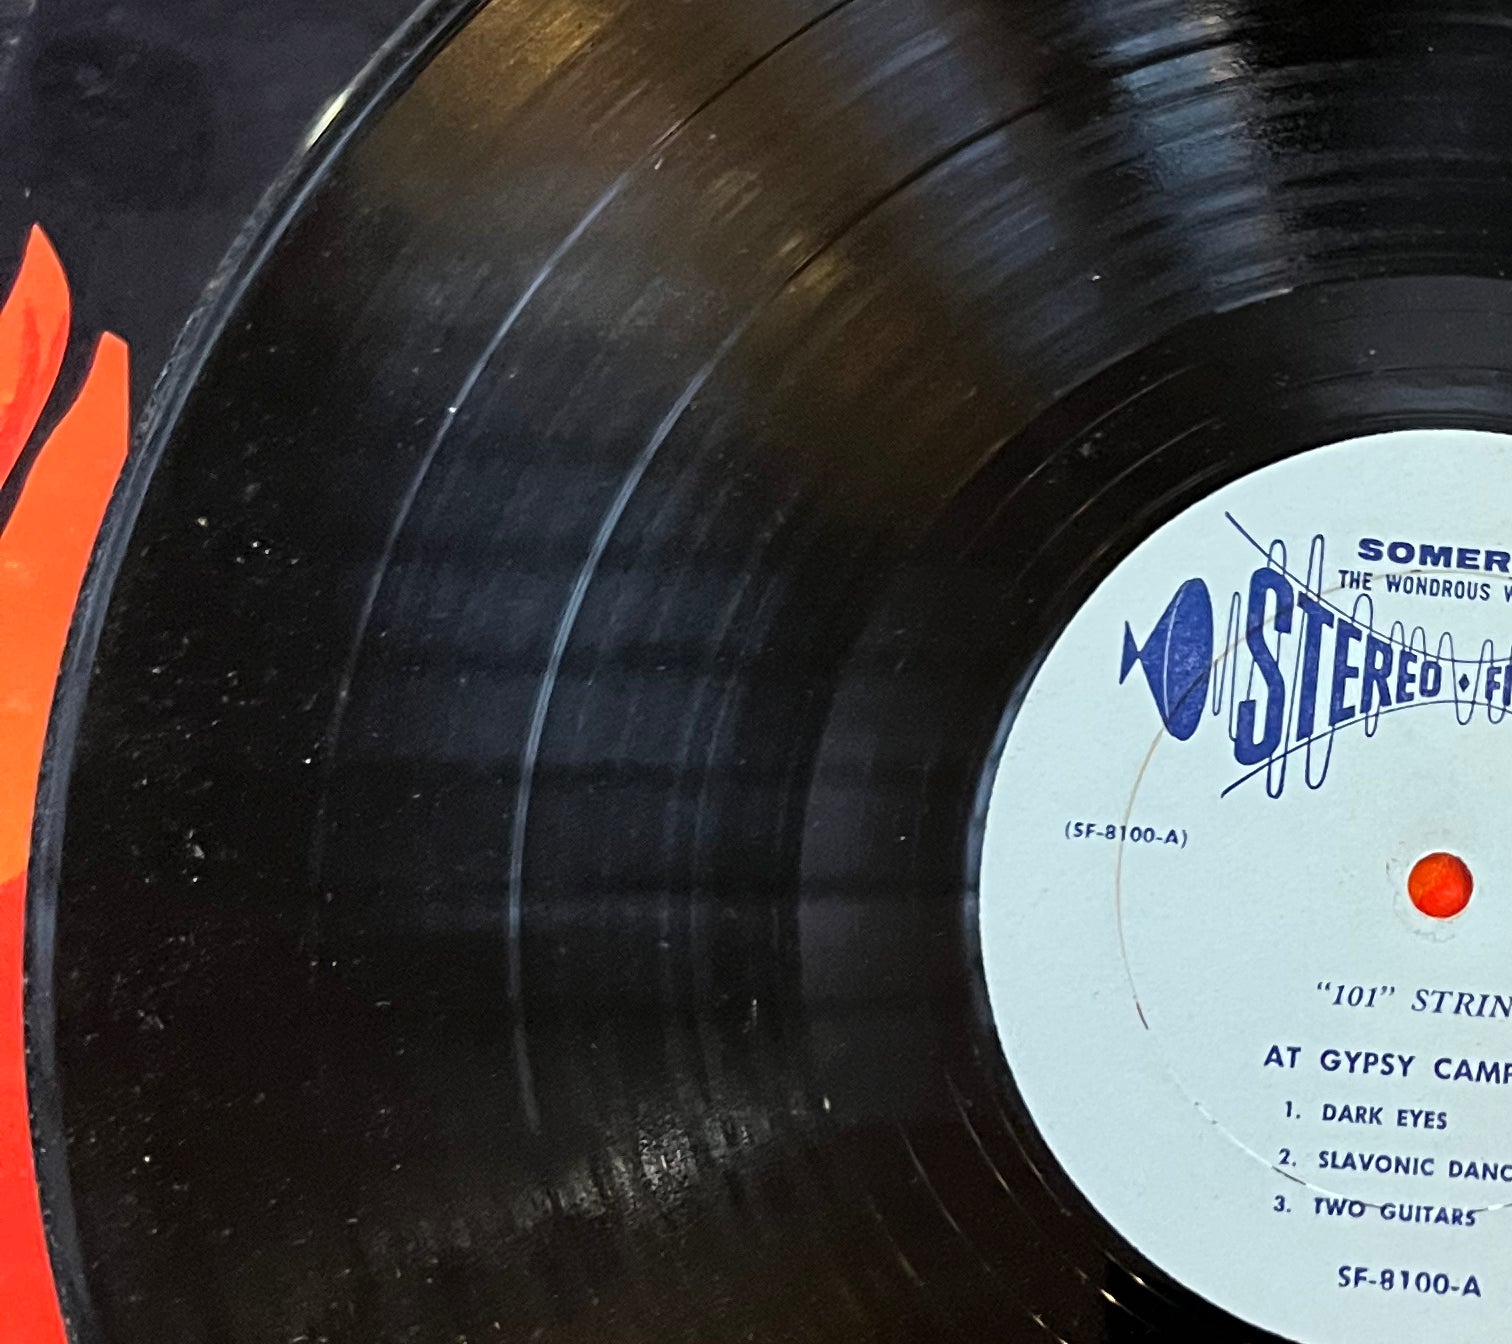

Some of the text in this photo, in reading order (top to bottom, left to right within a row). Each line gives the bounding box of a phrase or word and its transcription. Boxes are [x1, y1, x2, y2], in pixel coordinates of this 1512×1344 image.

[1338, 569, 1373, 591] THE
[1386, 574, 1491, 601] WONDROUS
[1234, 567, 1442, 765] STEREO
[1065, 820, 1188, 849] (SF-8100-A)
[1263, 1045, 1302, 1068] AT
[1320, 1049, 1416, 1077] GYPSY
[1285, 1101, 1448, 1130] 1. DARK EYES
[1278, 1148, 1297, 1167] 2.
[1318, 1150, 1435, 1177] SLAVONIC
[1273, 1195, 1476, 1227] 3. TWO GUITARS
[1338, 1265, 1482, 1298] SF-8100-A
